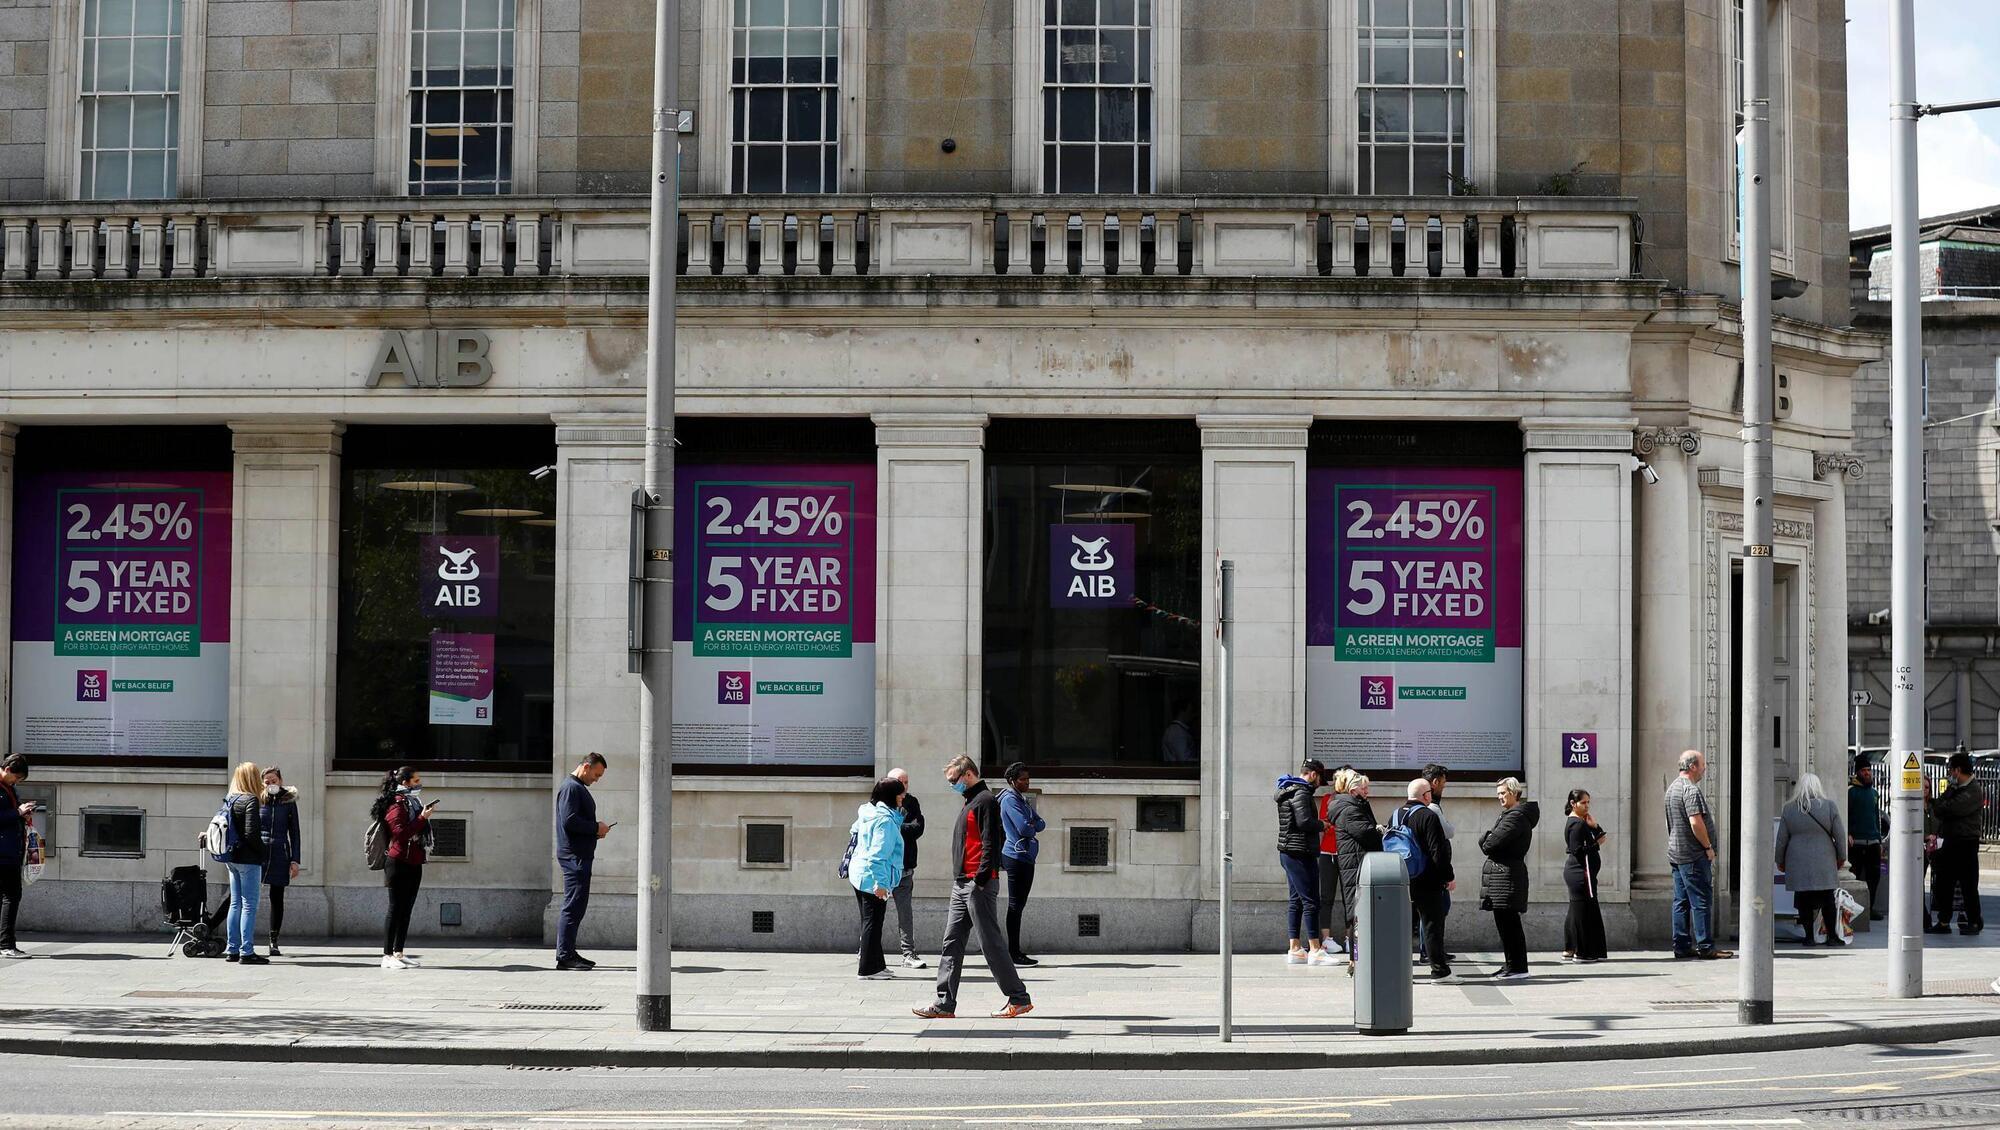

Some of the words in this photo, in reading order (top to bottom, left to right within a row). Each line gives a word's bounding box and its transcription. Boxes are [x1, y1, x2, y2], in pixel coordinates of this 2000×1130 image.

[365, 330, 493, 387] AIB
[66, 502, 192, 540] 2.45%
[706, 496, 842, 536] 2.45%
[1346, 500, 1484, 540] 2.45%
[1752, 546, 1768, 555] 22A
[66, 560, 101, 613] 5
[106, 560, 191, 588] YEAR
[704, 556, 744, 612] 5
[750, 556, 842, 585] YEAR
[1066, 575, 1116, 598] AIB
[1346, 560, 1386, 616] 5
[1392, 560, 1484, 590] YEAR
[108, 591, 191, 614] FIXED
[434, 585, 480, 607] AIB
[751, 588, 842, 612] FIXED
[1393, 593, 1484, 617] FIXED
[64, 631, 73, 642] A
[76, 631, 116, 642] GREEN
[120, 631, 190, 642] MORTGAGE
[704, 630, 714, 642] A
[716, 630, 760, 642] GREEN
[764, 630, 841, 642] MORTGAGE
[1346, 635, 1356, 646] A
[1358, 635, 1402, 646] GREEN
[1406, 635, 1484, 646] MORTGAGE
[82, 689, 100, 698] AIB
[724, 692, 743, 700] AIB
[1367, 696, 1386, 706] AIB
[1569, 753, 1590, 763] AIB
